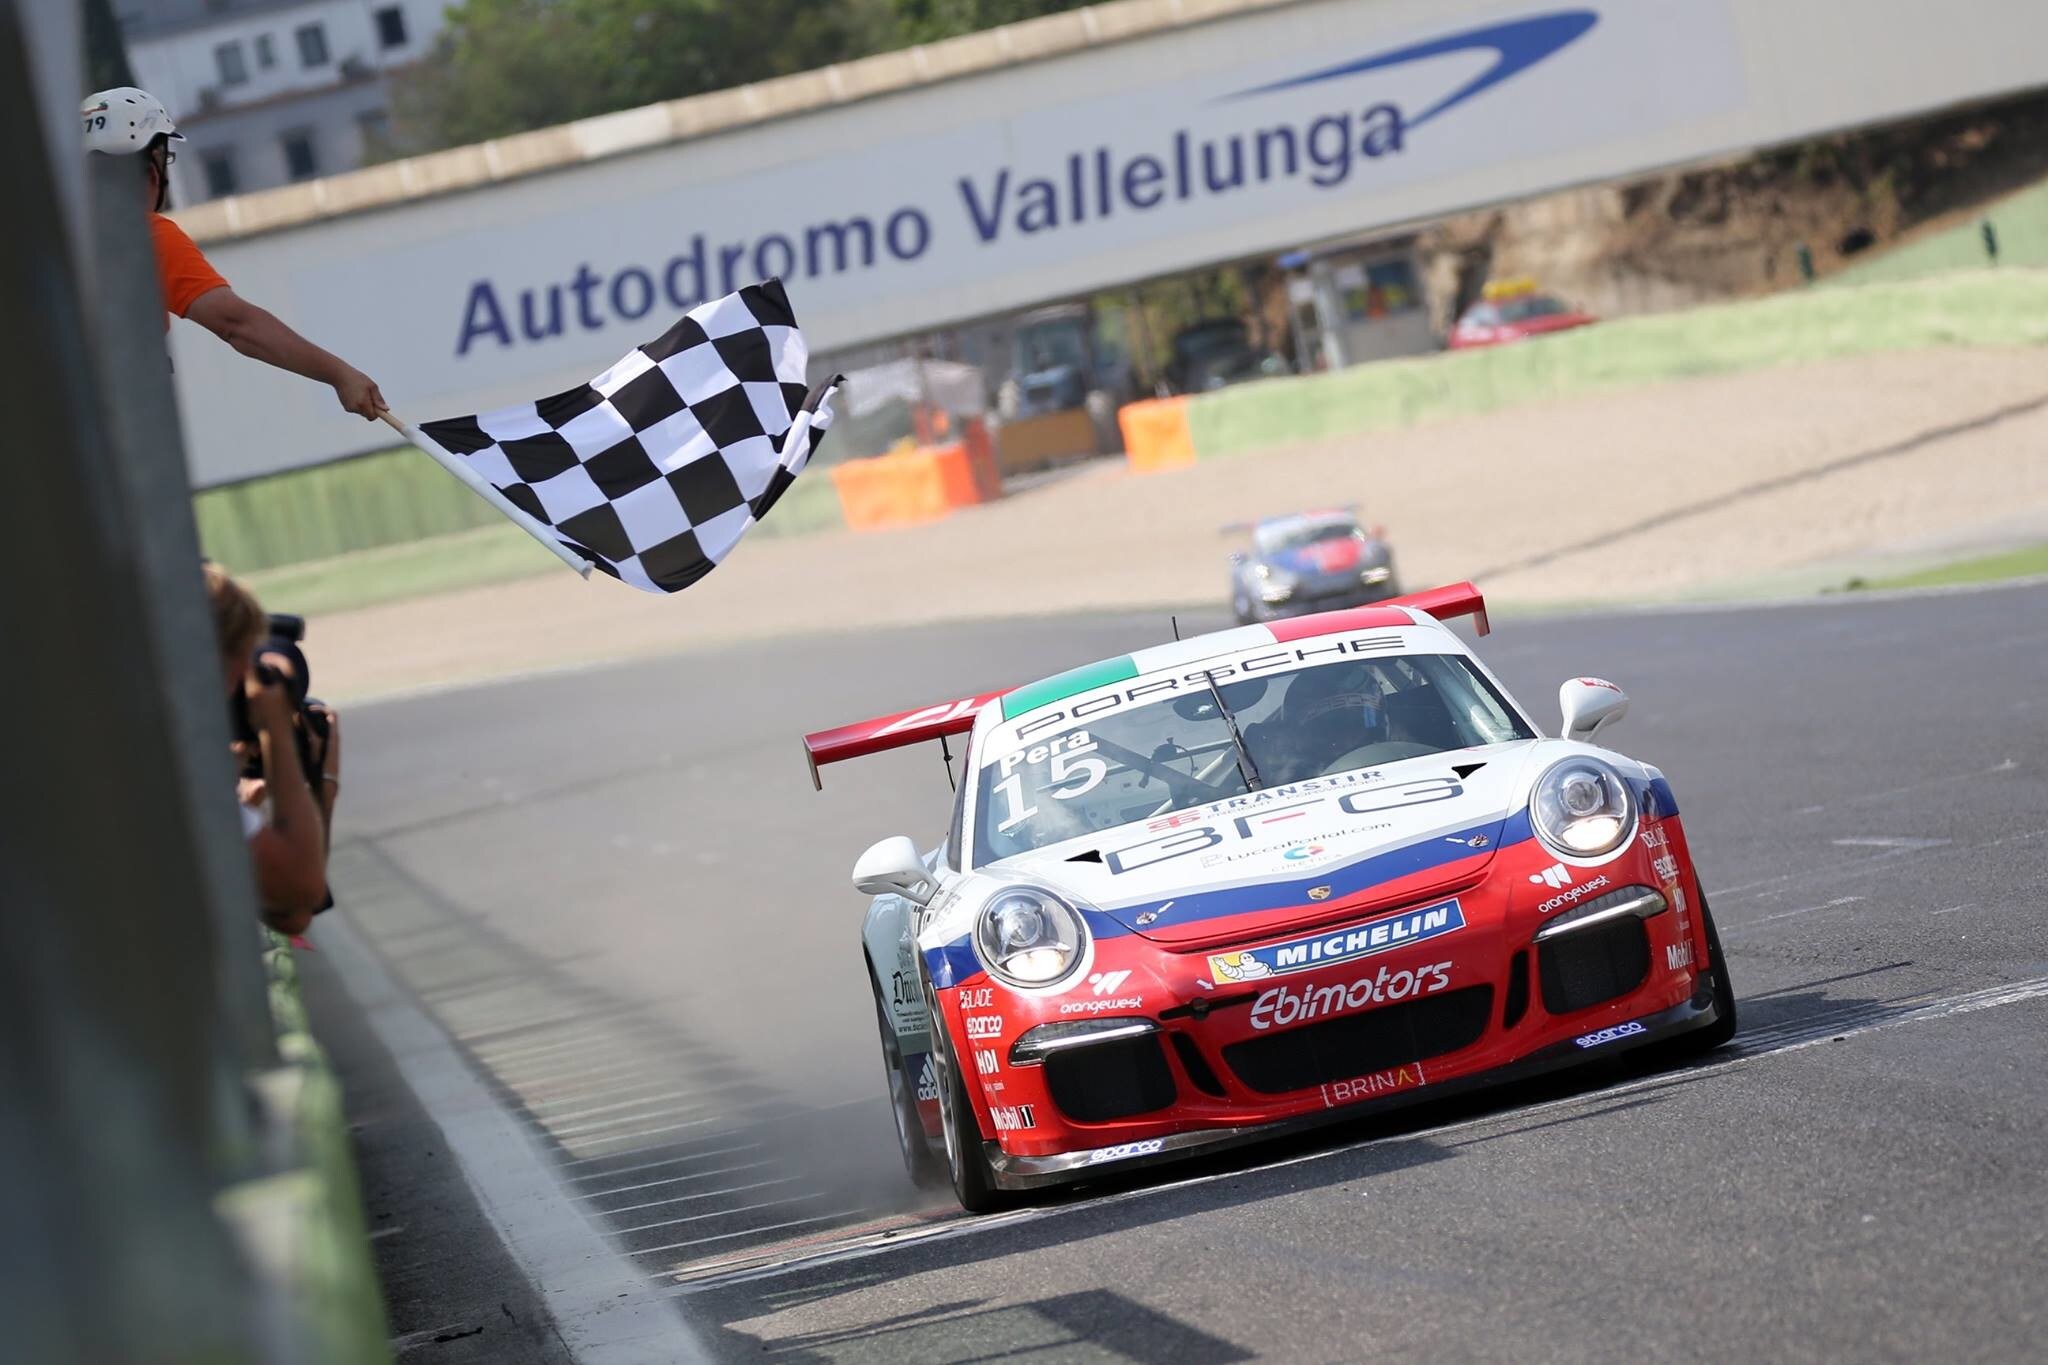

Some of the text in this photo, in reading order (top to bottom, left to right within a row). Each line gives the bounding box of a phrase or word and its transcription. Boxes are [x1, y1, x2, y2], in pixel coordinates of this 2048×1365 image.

[456, 101, 1406, 357] Autodromo Vallelunga
[1015, 640, 1406, 741] PORSCHE
[998, 730, 1091, 780] Pera
[992, 741, 1107, 833] 15
[1206, 770, 1383, 813] TRANSTIR
[1105, 777, 1464, 876] BFG
[1538, 874, 1611, 914] orangewest
[1276, 907, 1448, 967] MICHELIN
[1060, 995, 1143, 1016] orangewest
[1250, 960, 1453, 1030] Ebimotors
[966, 1015, 1003, 1038] sparco
[1576, 1022, 1647, 1049] sparco
[990, 1106, 1022, 1131] Mobil
[1090, 1139, 1163, 1163] sparco
